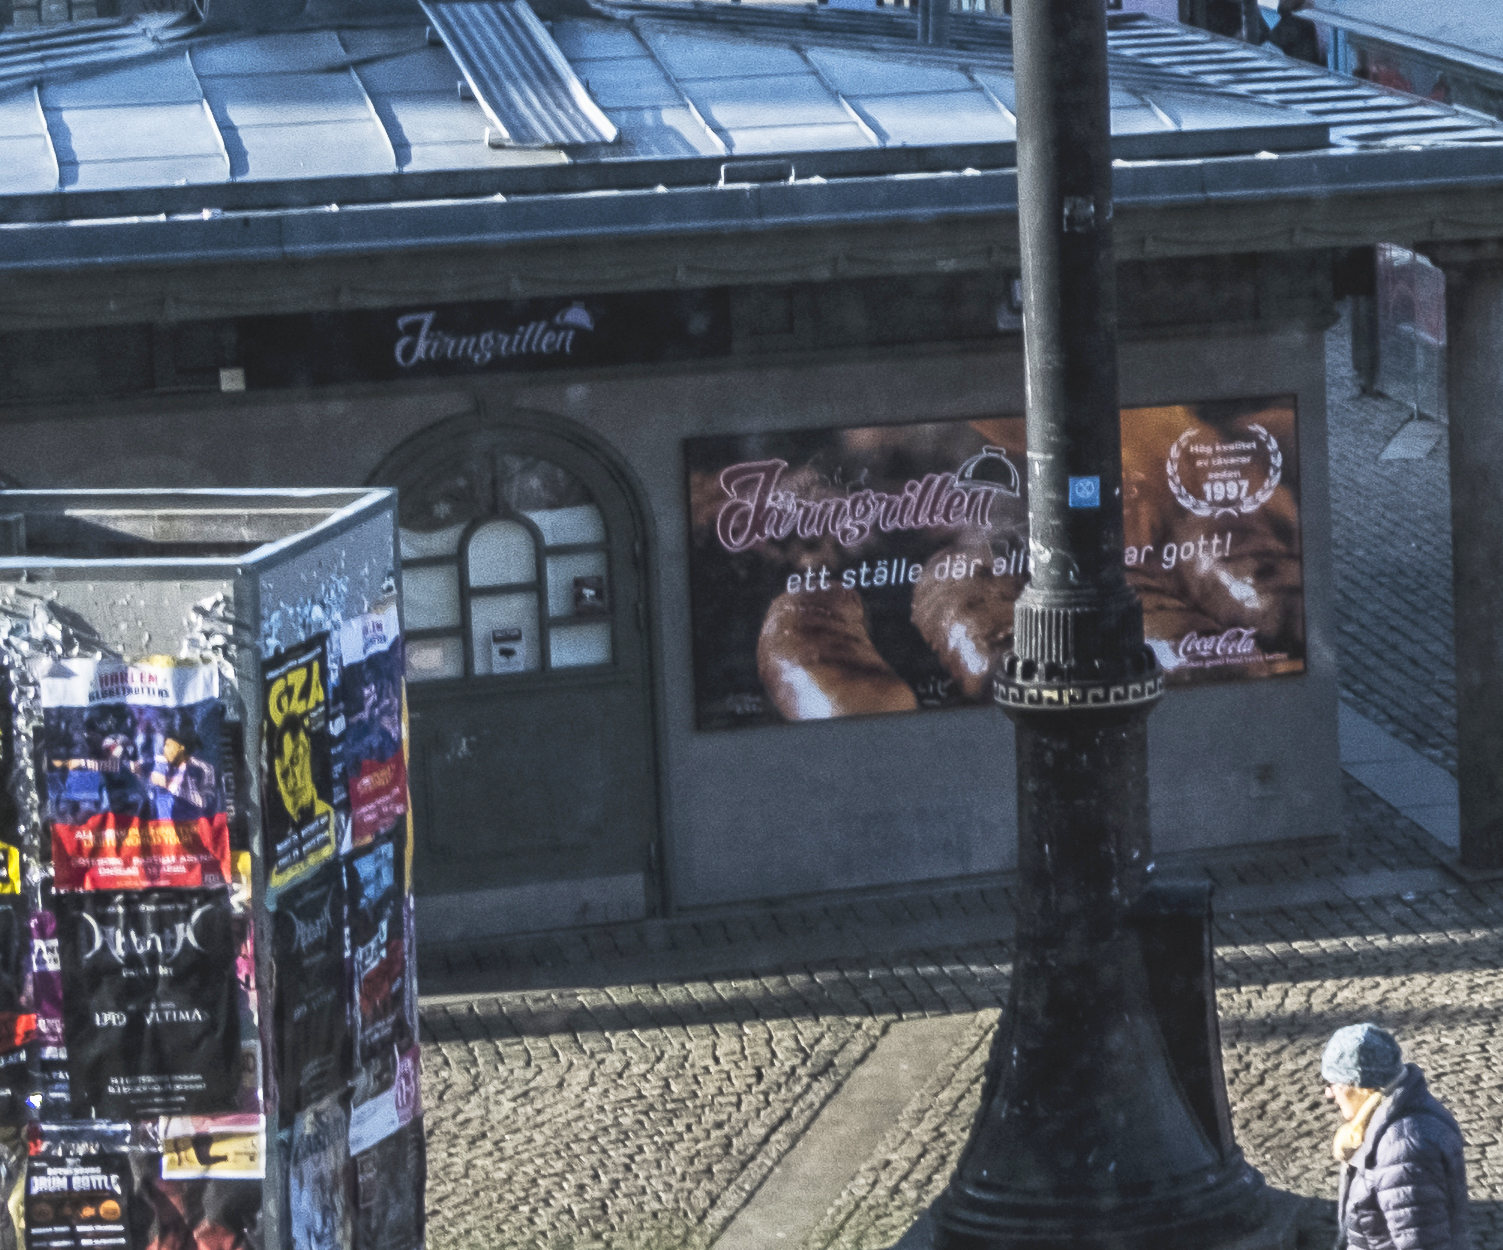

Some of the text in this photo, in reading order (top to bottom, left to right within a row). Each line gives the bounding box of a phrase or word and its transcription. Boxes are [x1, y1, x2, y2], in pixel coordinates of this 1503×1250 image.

[717, 458, 994, 551] Järngrillen
[1203, 480, 1249, 502] 1997
[786, 564, 831, 595] ett
[841, 557, 923, 590] ställe
[934, 552, 983, 582] där
[1162, 531, 1232, 570] gott!
[1179, 627, 1257, 659] Coca-Cola
[99, 671, 158, 688] HARLEM
[269, 661, 325, 727] GZA
